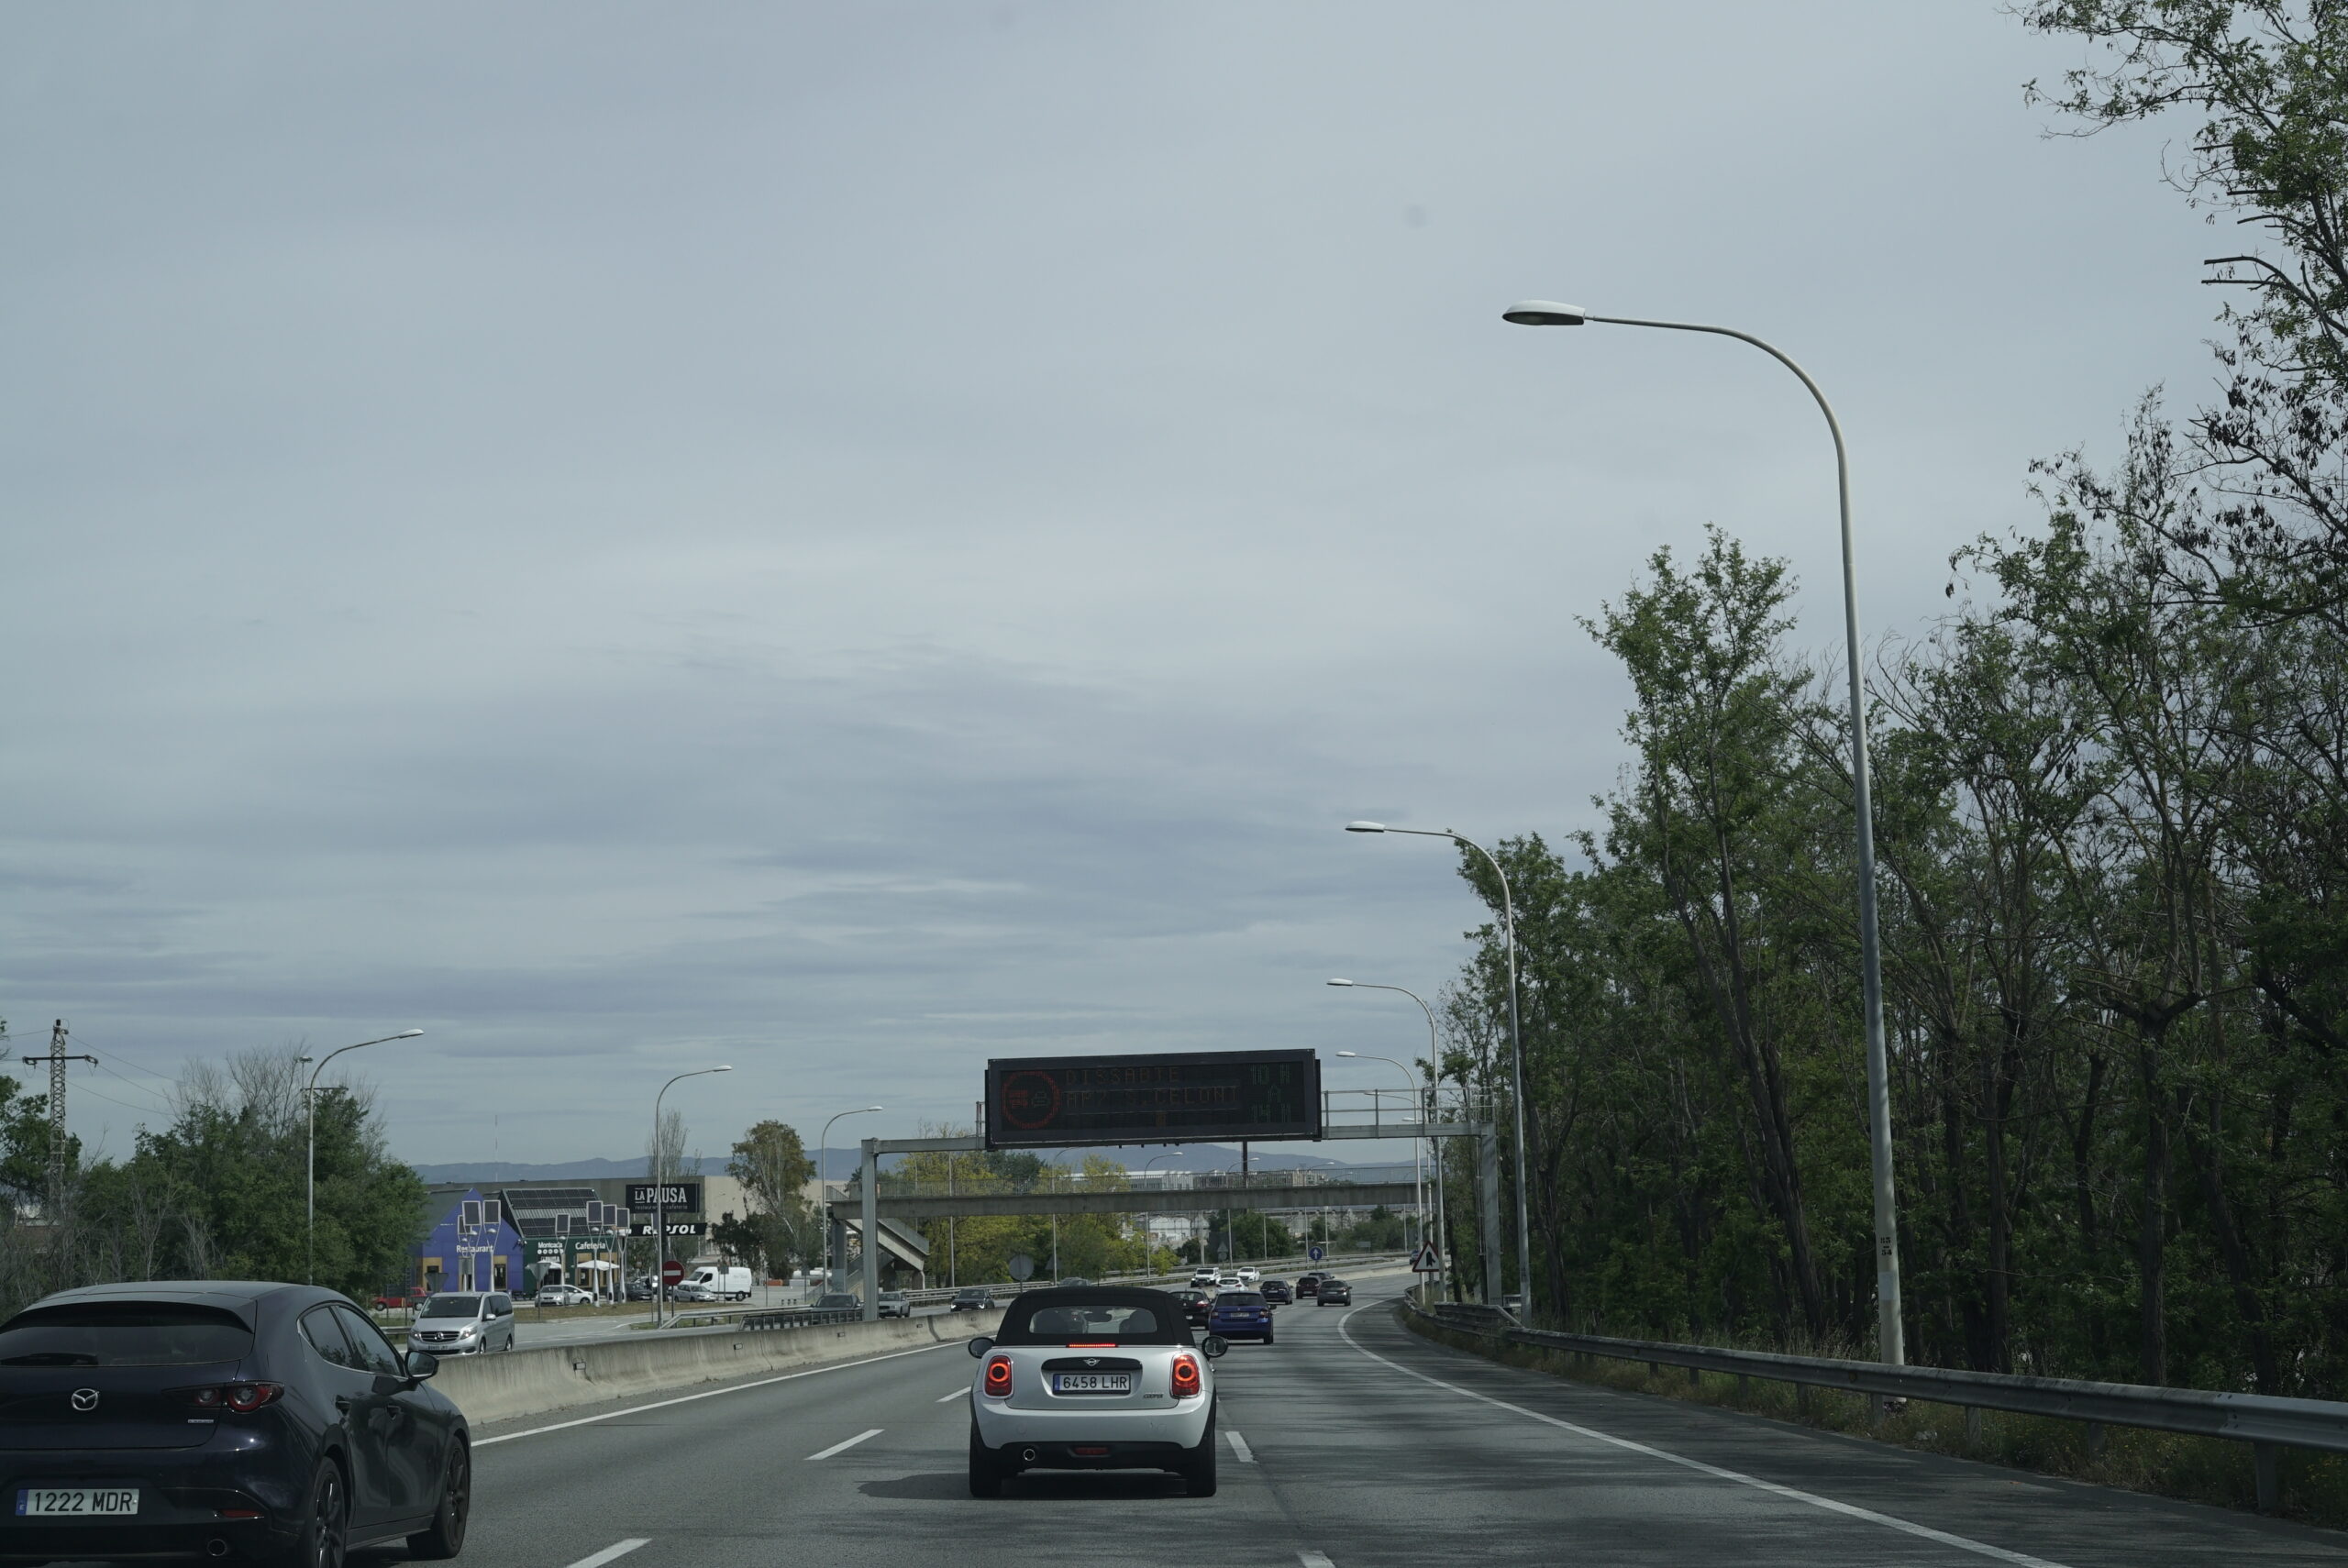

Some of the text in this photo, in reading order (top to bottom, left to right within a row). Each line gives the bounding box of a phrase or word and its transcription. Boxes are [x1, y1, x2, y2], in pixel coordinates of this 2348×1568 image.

[1065, 1067, 1181, 1086] DISSABTE
[635, 1187, 687, 1204] LA PAUSA
[642, 1224, 696, 1235] RSOL
[456, 1244, 493, 1253] Restaurant
[1063, 1376, 1127, 1389] 6458 LHR
[35, 1492, 133, 1512] 1222 MDR
